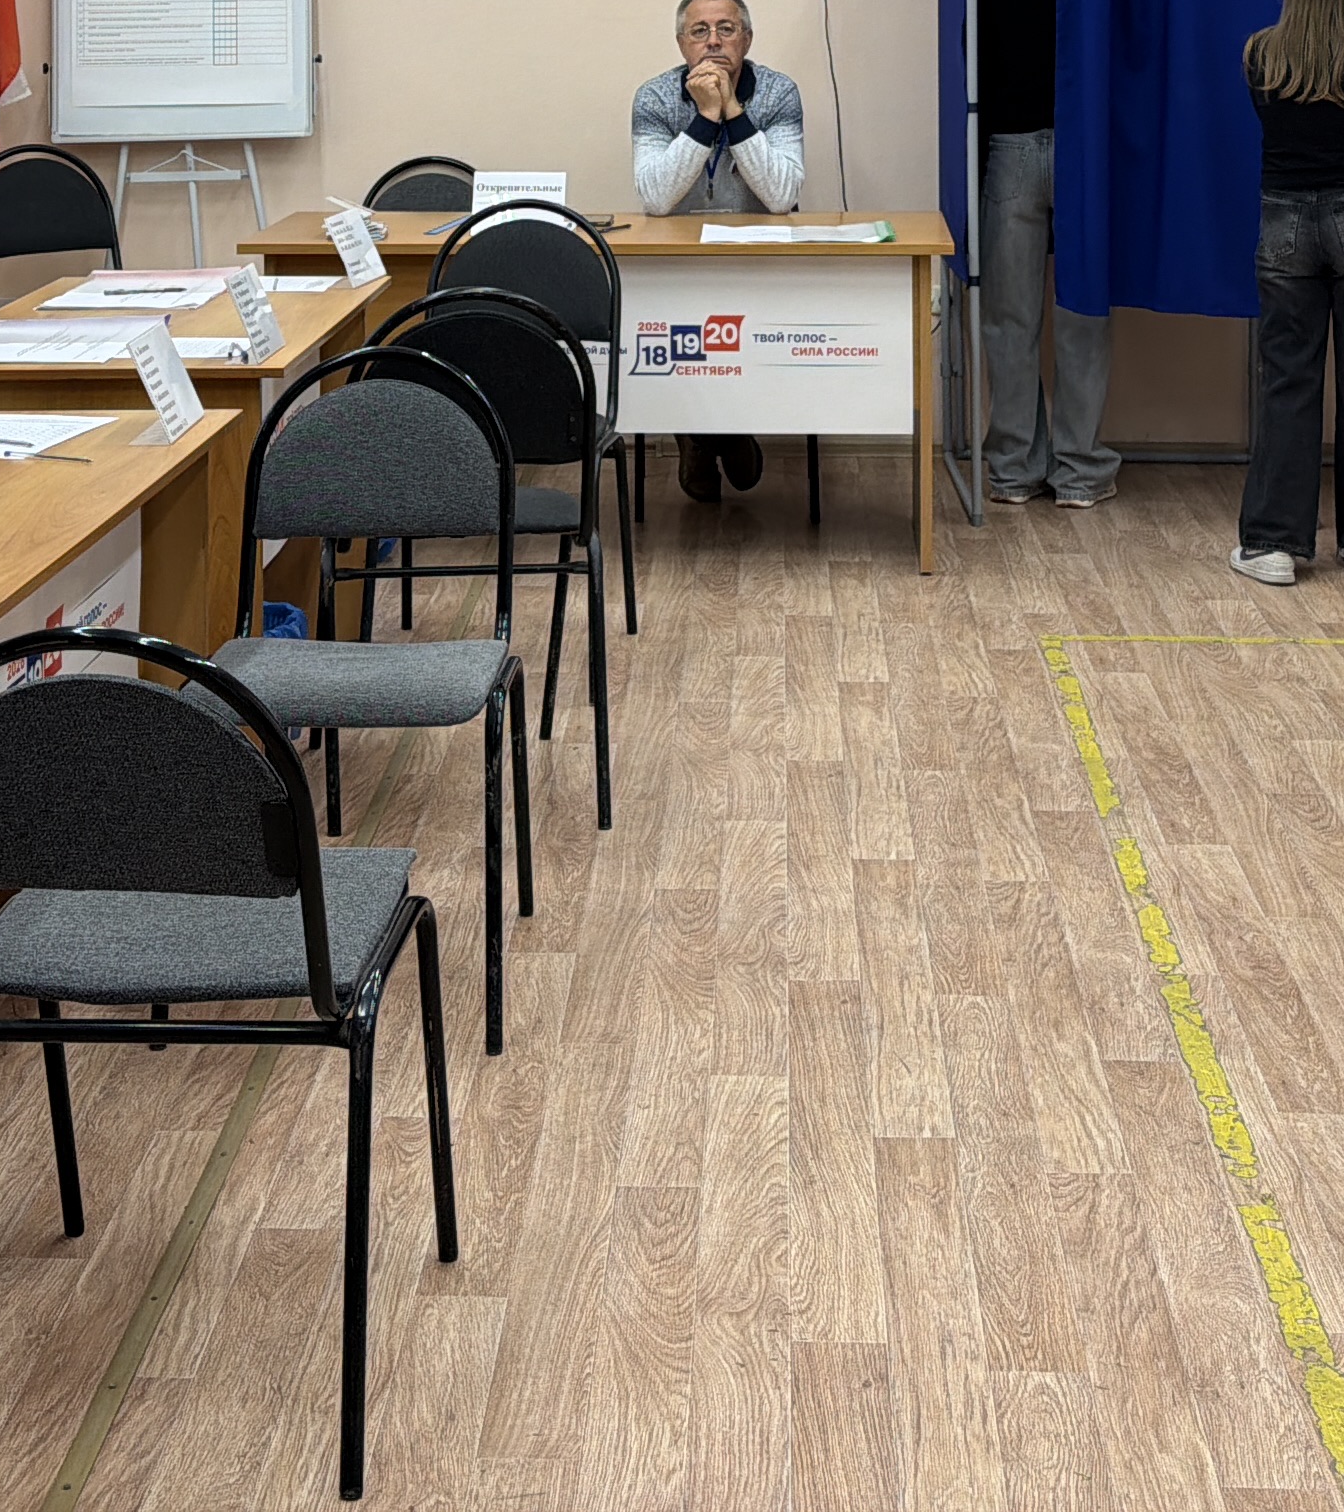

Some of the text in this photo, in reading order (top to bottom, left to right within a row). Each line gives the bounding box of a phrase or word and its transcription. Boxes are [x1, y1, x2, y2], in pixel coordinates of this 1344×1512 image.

[476, 182, 563, 194] Открепительные
[637, 322, 667, 331] 2026
[705, 322, 738, 344] 20
[752, 332, 784, 343] ТВОЙ
[787, 334, 827, 343] ГОЛОС
[673, 333, 699, 355] 19
[642, 346, 667, 366] 18
[791, 347, 879, 357] СИЛА РОССИИ!
[676, 366, 742, 376] СЕНТЯБРЯ
